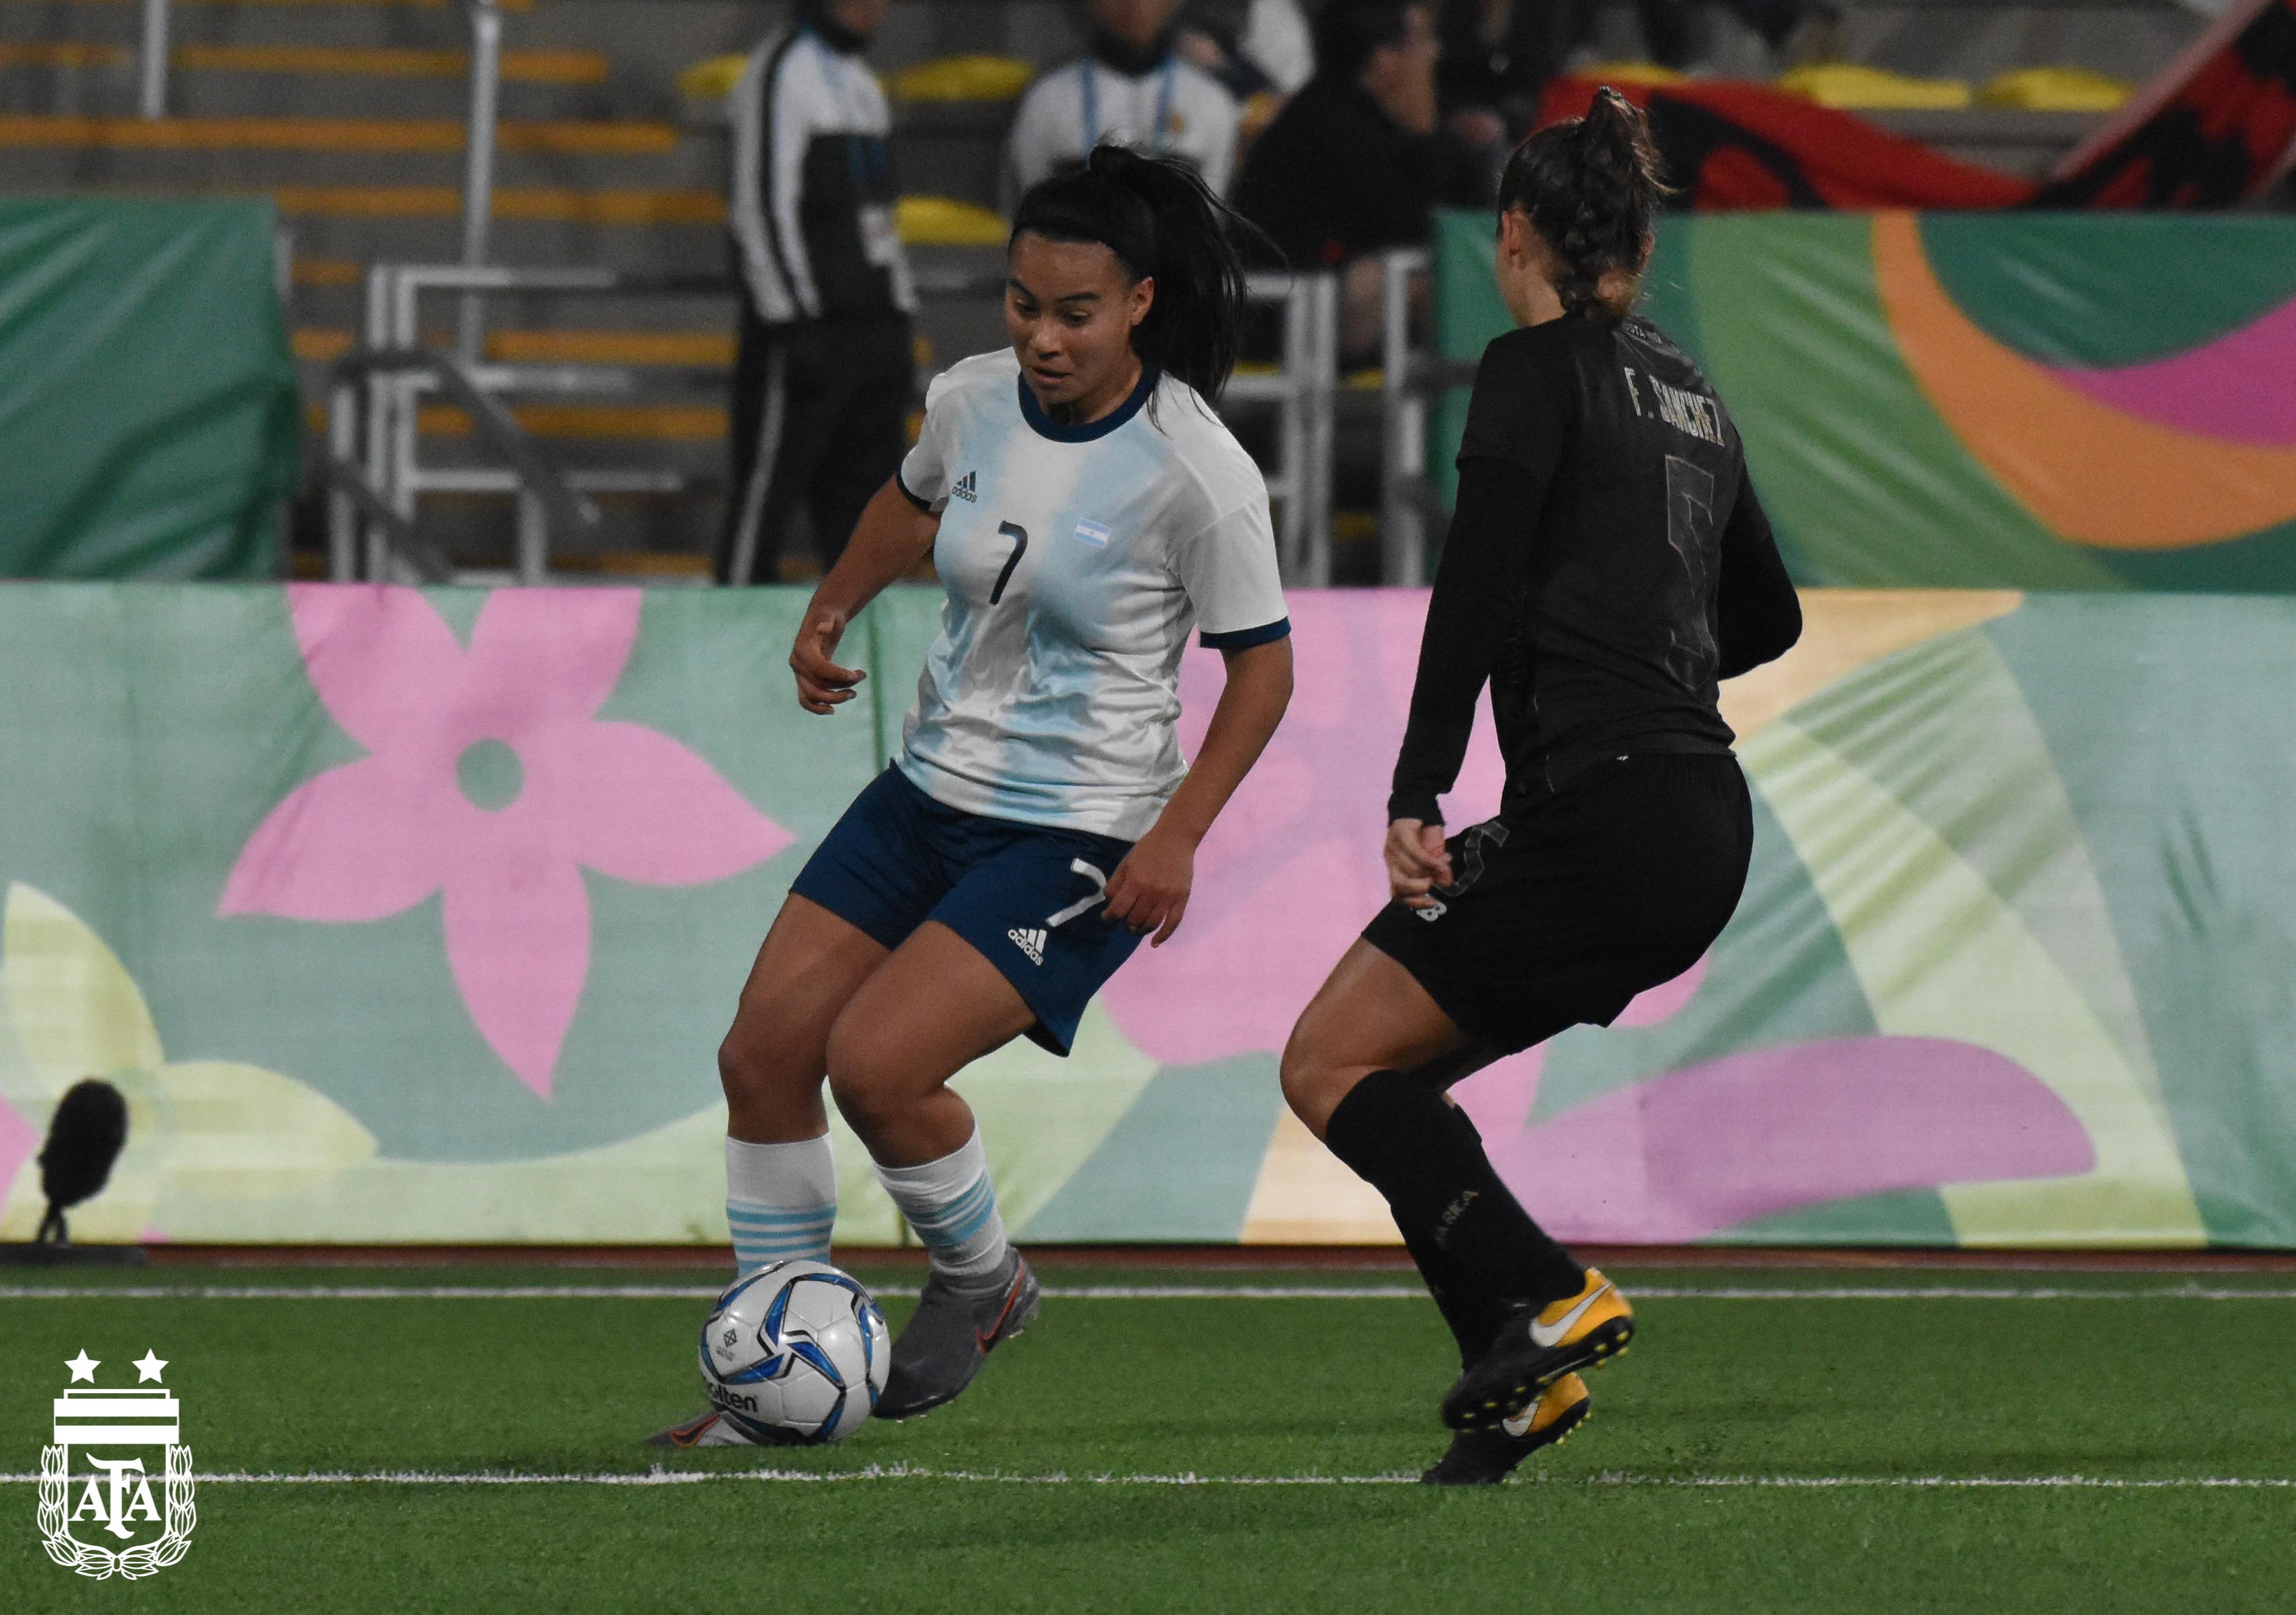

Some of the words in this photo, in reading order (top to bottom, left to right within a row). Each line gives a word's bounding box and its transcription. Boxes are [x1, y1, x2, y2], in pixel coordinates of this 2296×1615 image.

[1624, 366, 1654, 419] F.
[951, 485, 978, 504] adidas
[989, 520, 1028, 606] 7
[1044, 857, 1107, 928] 7
[1008, 929, 1044, 966] adidas
[708, 1382, 758, 1413] olten
